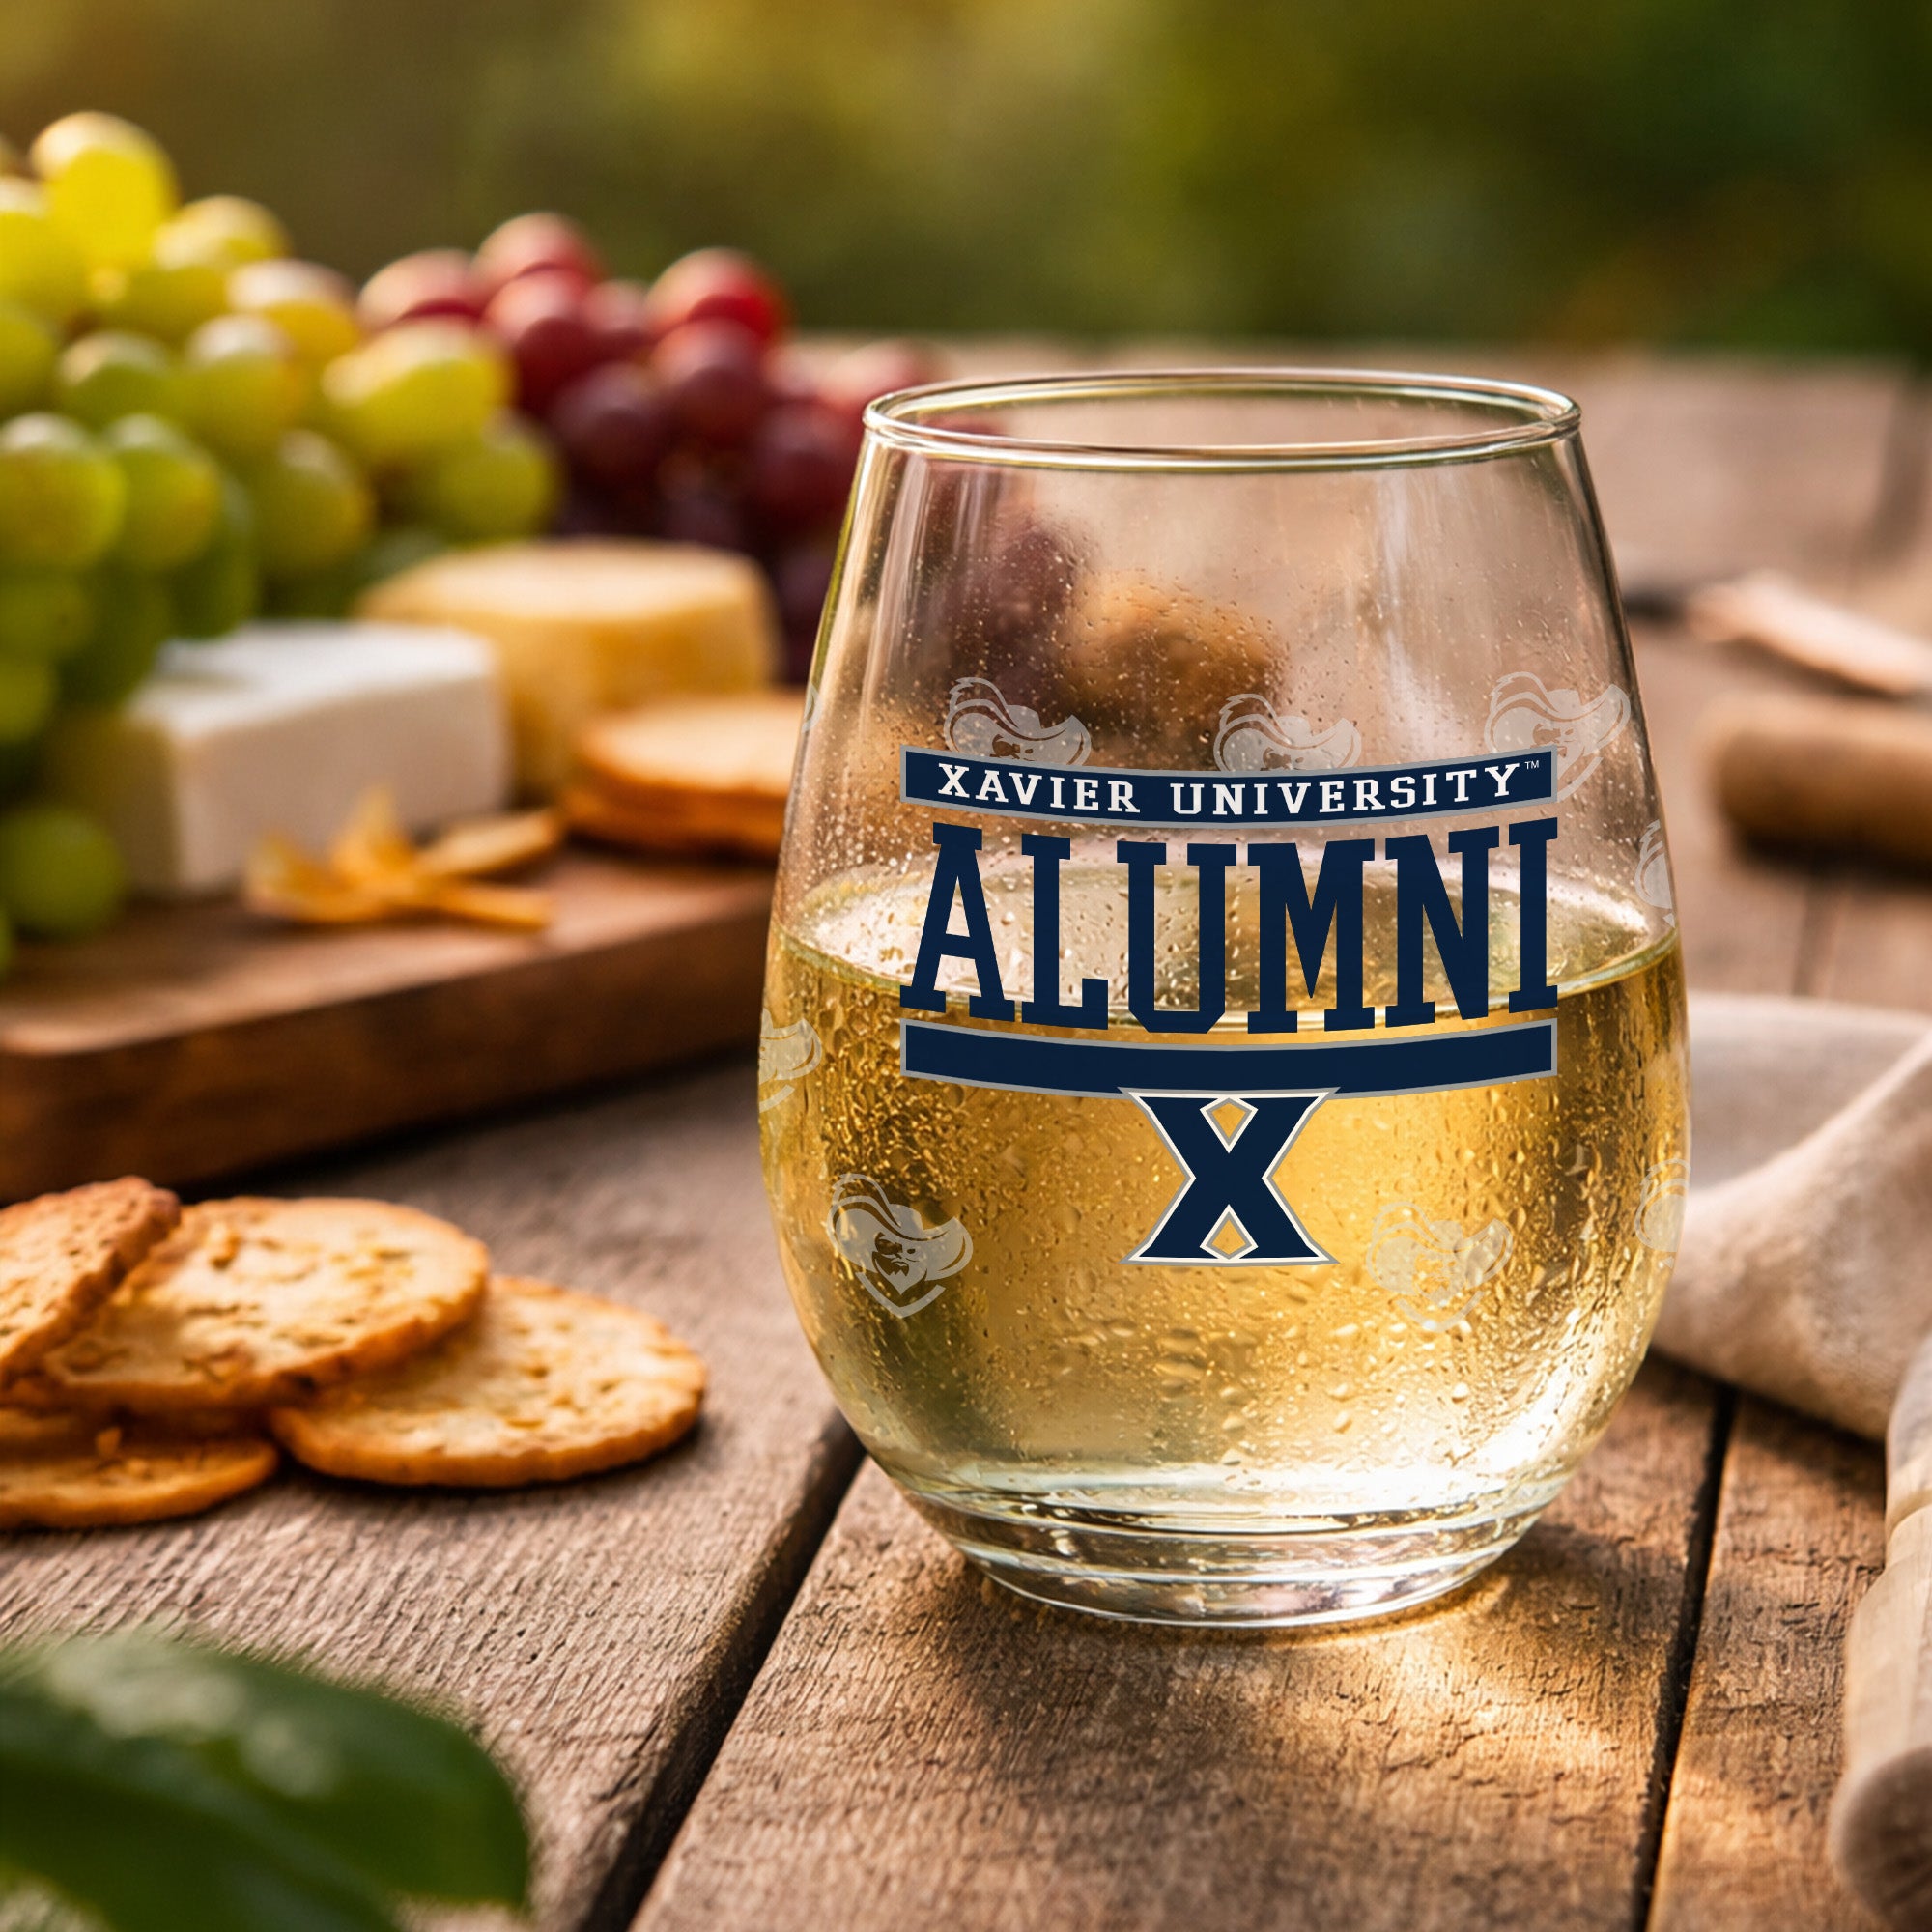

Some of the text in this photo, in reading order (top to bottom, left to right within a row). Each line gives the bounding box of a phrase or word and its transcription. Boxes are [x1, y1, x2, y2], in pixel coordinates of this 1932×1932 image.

[938, 762, 1141, 813] XAVIER
[1171, 762, 1520, 815] UNIVERSITY
[899, 817, 1558, 1034] ALUMNI
[1119, 1087, 1342, 1265] X
